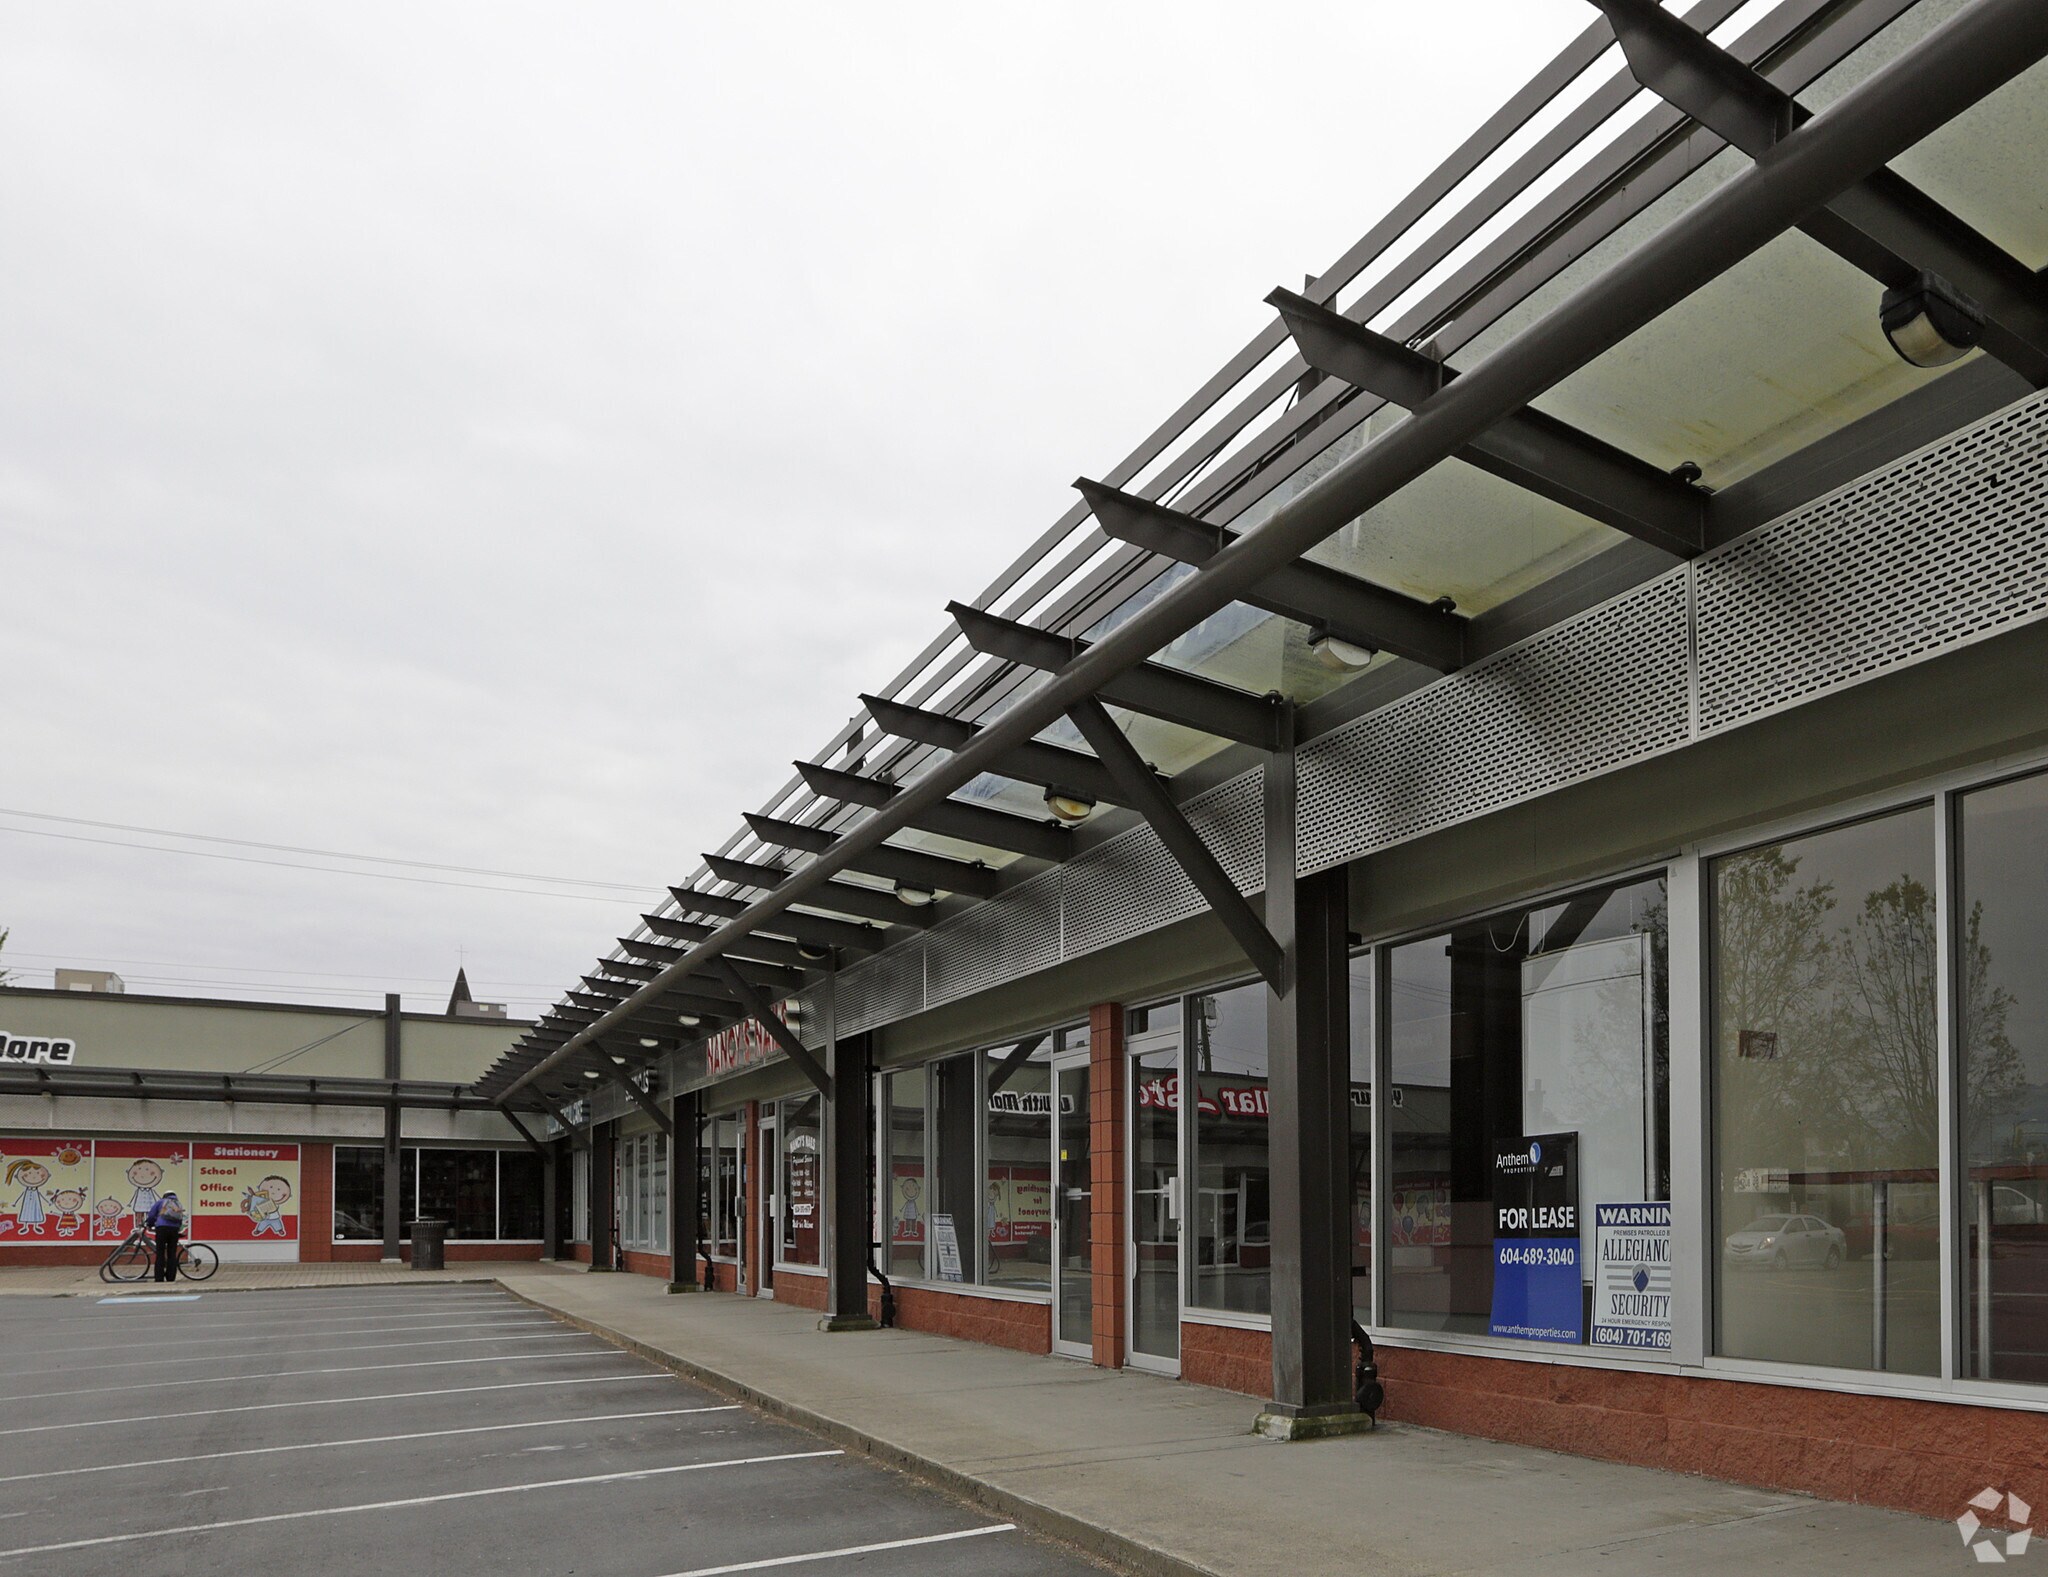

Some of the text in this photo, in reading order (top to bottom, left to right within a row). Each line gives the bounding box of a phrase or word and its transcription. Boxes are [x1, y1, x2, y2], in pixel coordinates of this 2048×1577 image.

[706, 1018, 751, 1075] NANCY'S
[214, 1147, 279, 1158] Stationery
[1496, 1153, 1529, 1168] Anthem
[200, 1167, 237, 1175] School
[1503, 1166, 1536, 1174] PROPERTIES
[200, 1184, 234, 1192] Office
[200, 1199, 233, 1207] Home
[1499, 1206, 1575, 1230] FOR LEASE
[1599, 1207, 1671, 1225] WARNIN
[1500, 1248, 1574, 1265] 604-689-3040
[1602, 1238, 1671, 1262] ALLEGIANC
[1611, 1293, 1670, 1318] SECURITY
[1622, 1318, 1650, 1327] EMERGENCY
[1651, 1320, 1671, 1328] RESPON
[1493, 1324, 1576, 1339] www.anthemproperties.com
[1596, 1327, 1671, 1347] (604) 701-169
